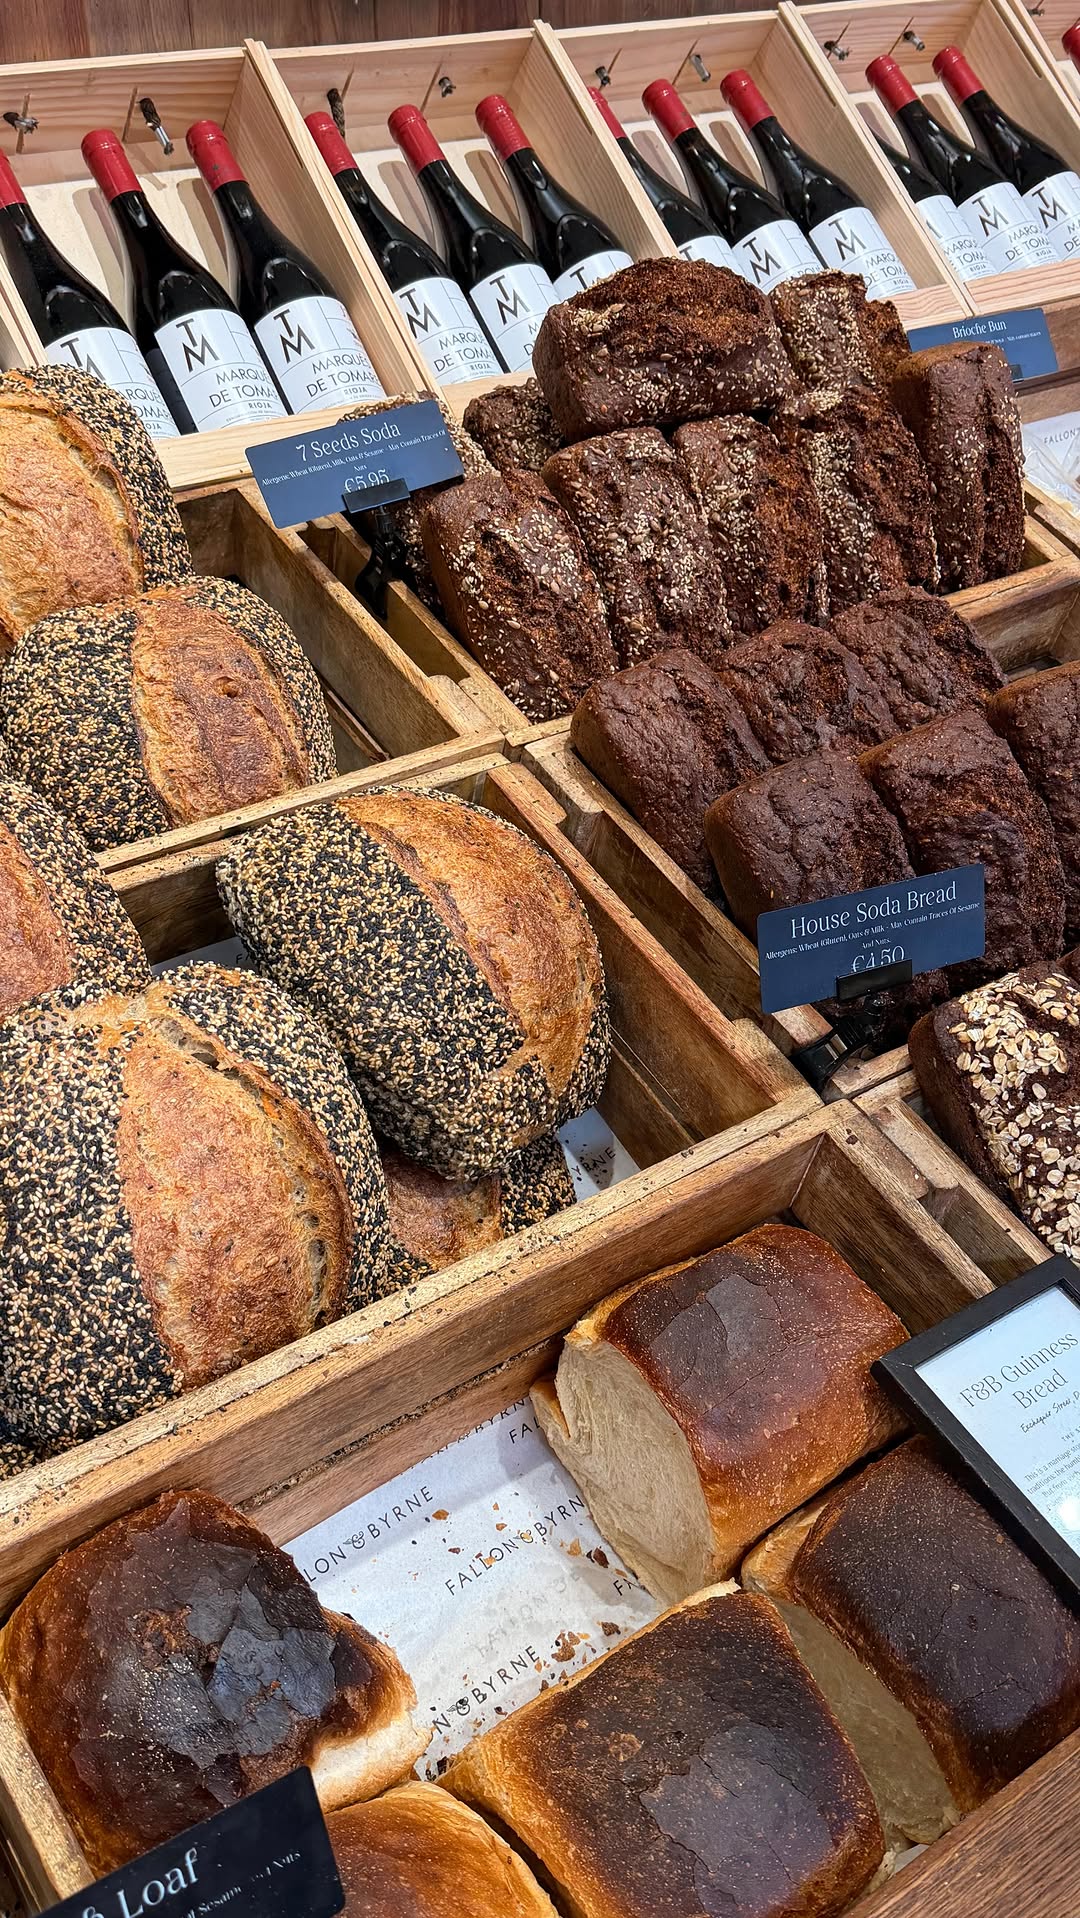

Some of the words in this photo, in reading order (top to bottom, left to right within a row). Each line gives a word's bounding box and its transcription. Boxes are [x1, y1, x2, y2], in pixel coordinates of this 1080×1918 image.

[866, 252, 896, 268] MARQ
[1005, 245, 1023, 261] DE
[569, 266, 588, 290] T
[952, 322, 987, 339] Brioche
[988, 320, 1007, 332] Bun
[433, 353, 454, 372] DE
[455, 347, 494, 362] TOMA
[523, 343, 534, 356] D
[469, 362, 491, 371] RIOJA
[209, 389, 231, 408] DE
[306, 378, 328, 398] DE
[344, 387, 368, 395] RIOJA
[295, 444, 307, 461] 7
[310, 432, 359, 458] Seeds
[360, 422, 401, 445] Soda
[420, 433, 438, 442] Traces
[1043, 428, 1076, 444] FALLON
[791, 911, 850, 939] House
[856, 896, 901, 924] Soda
[907, 880, 957, 911] Bread
[765, 947, 798, 961] Allergens:
[798, 941, 819, 952] Wheat
[848, 931, 863, 940] Oats
[863, 928, 870, 937] &
[870, 924, 885, 934] Milk
[890, 920, 903, 930] May
[904, 915, 928, 926] Contain
[928, 911, 948, 920] Traces
[949, 907, 957, 915] Of
[957, 902, 980, 913] Sesame
[862, 939, 874, 949] And
[571, 1147, 616, 1175] YRNE
[959, 1375, 1003, 1407] F&B
[1000, 1333, 1079, 1383] Guinness
[1012, 1368, 1069, 1409] Bread
[508, 1417, 541, 1444] FAL
[1024, 1471, 1038, 1482] This
[1047, 1449, 1072, 1468] marriage
[1054, 1466, 1065, 1476] the
[1064, 1455, 1080, 1471] humb
[303, 1545, 347, 1582] LON
[367, 1486, 433, 1539] BYRNE
[444, 1538, 519, 1596] FALLON
[534, 1495, 586, 1537] BYRN
[471, 1645, 540, 1704] BYRNE
[117, 1847, 199, 1918] Loaf
